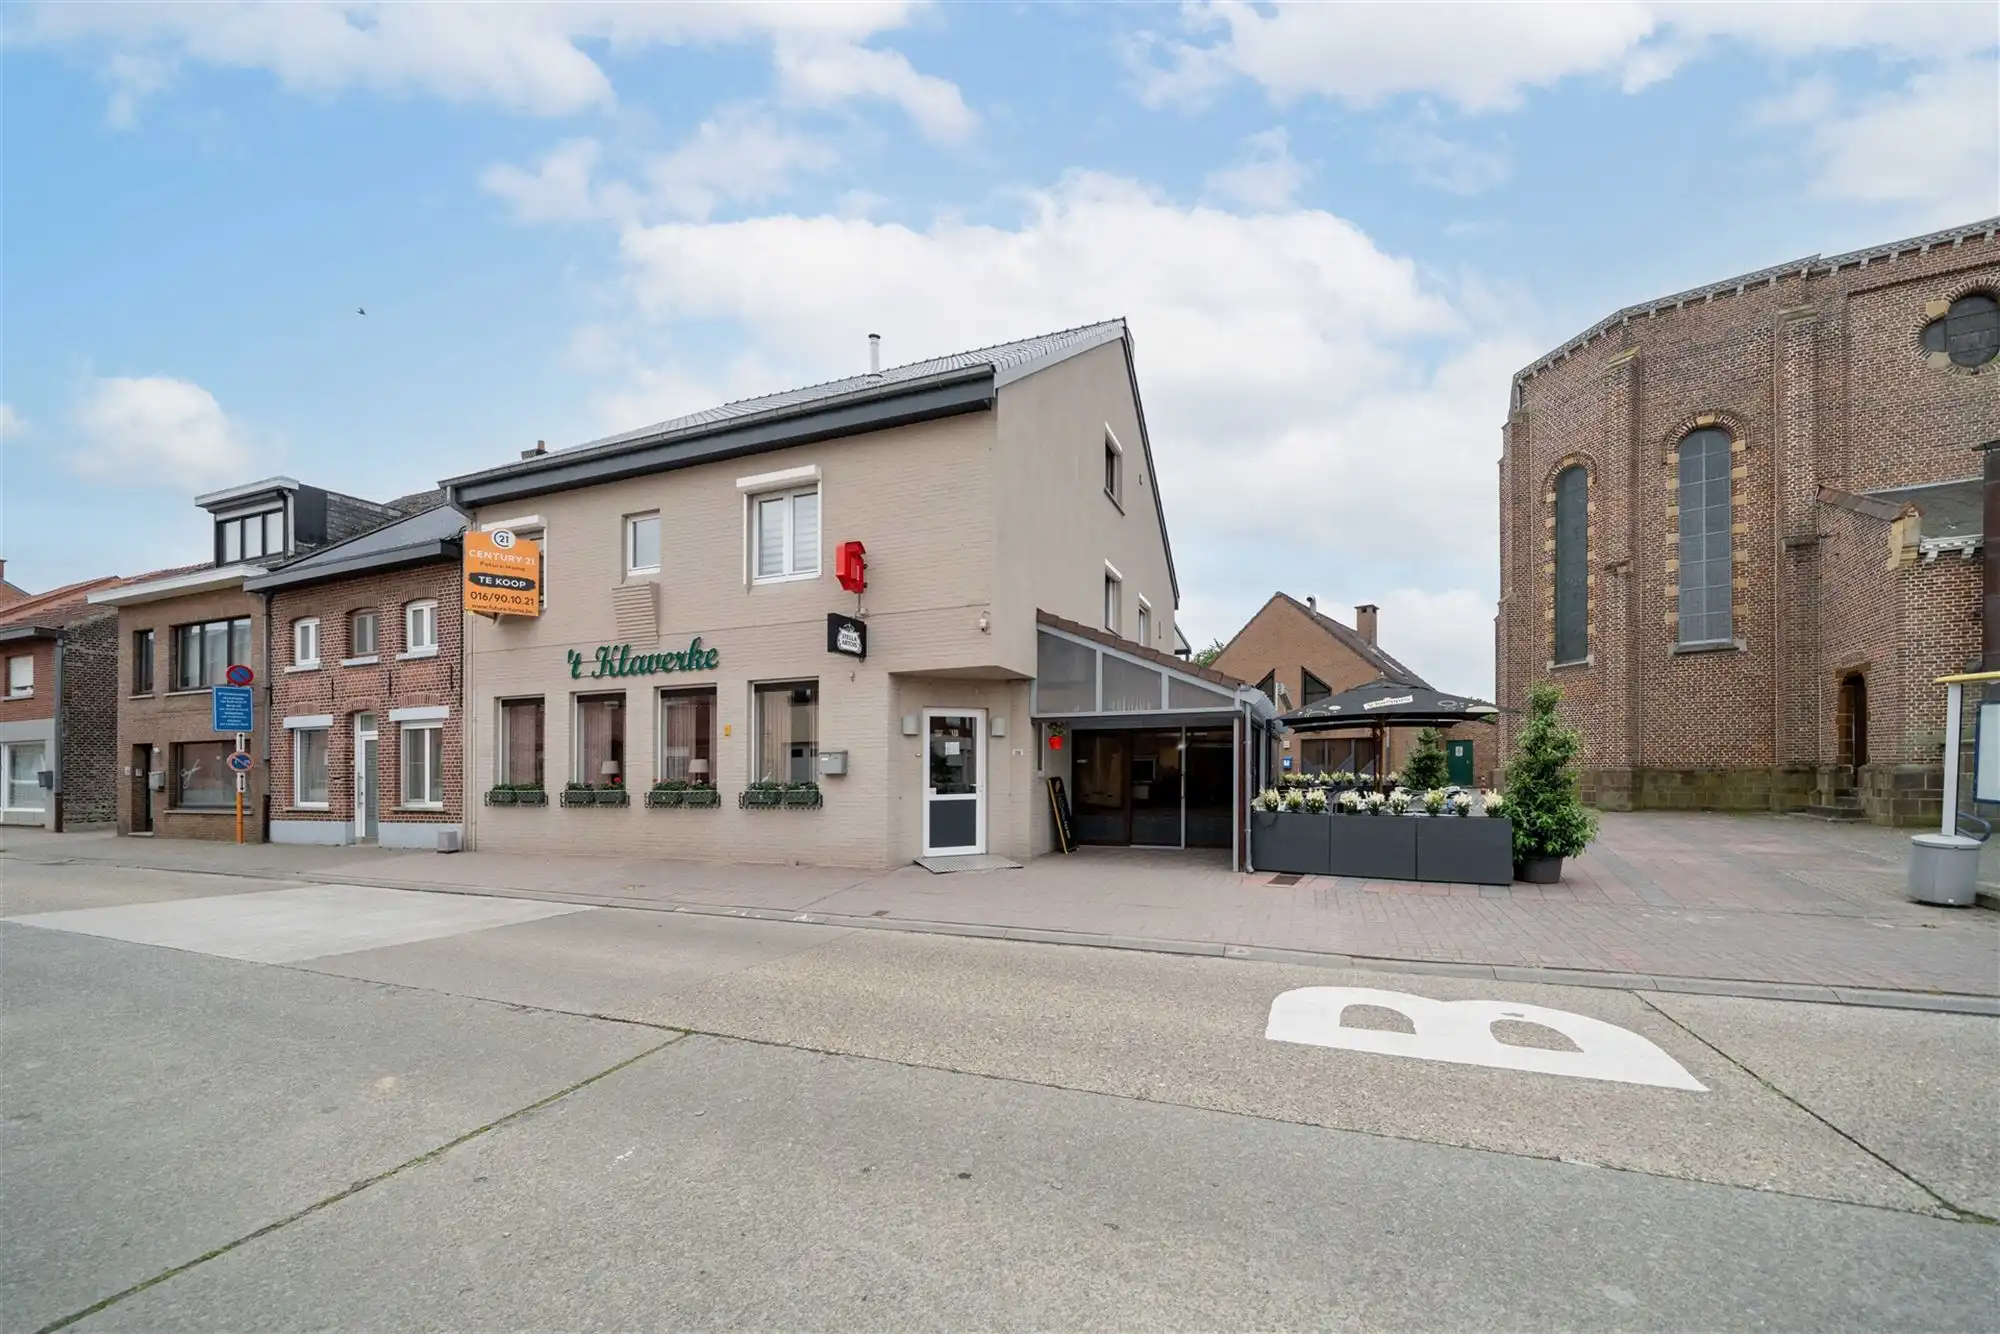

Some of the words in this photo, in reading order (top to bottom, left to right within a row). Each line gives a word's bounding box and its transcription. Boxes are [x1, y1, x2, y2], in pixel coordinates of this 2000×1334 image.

[469, 549, 522, 564] CENTURY
[525, 557, 536, 565] 21
[478, 575, 493, 584] TE
[495, 577, 526, 588] KOOP
[470, 591, 535, 606] 016/90.10.21
[841, 633, 857, 641] STELLA
[841, 639, 858, 648] ARTOIS
[567, 648, 582, 679] 't
[591, 636, 720, 680] Klaverke
[1265, 986, 1711, 1092] B
